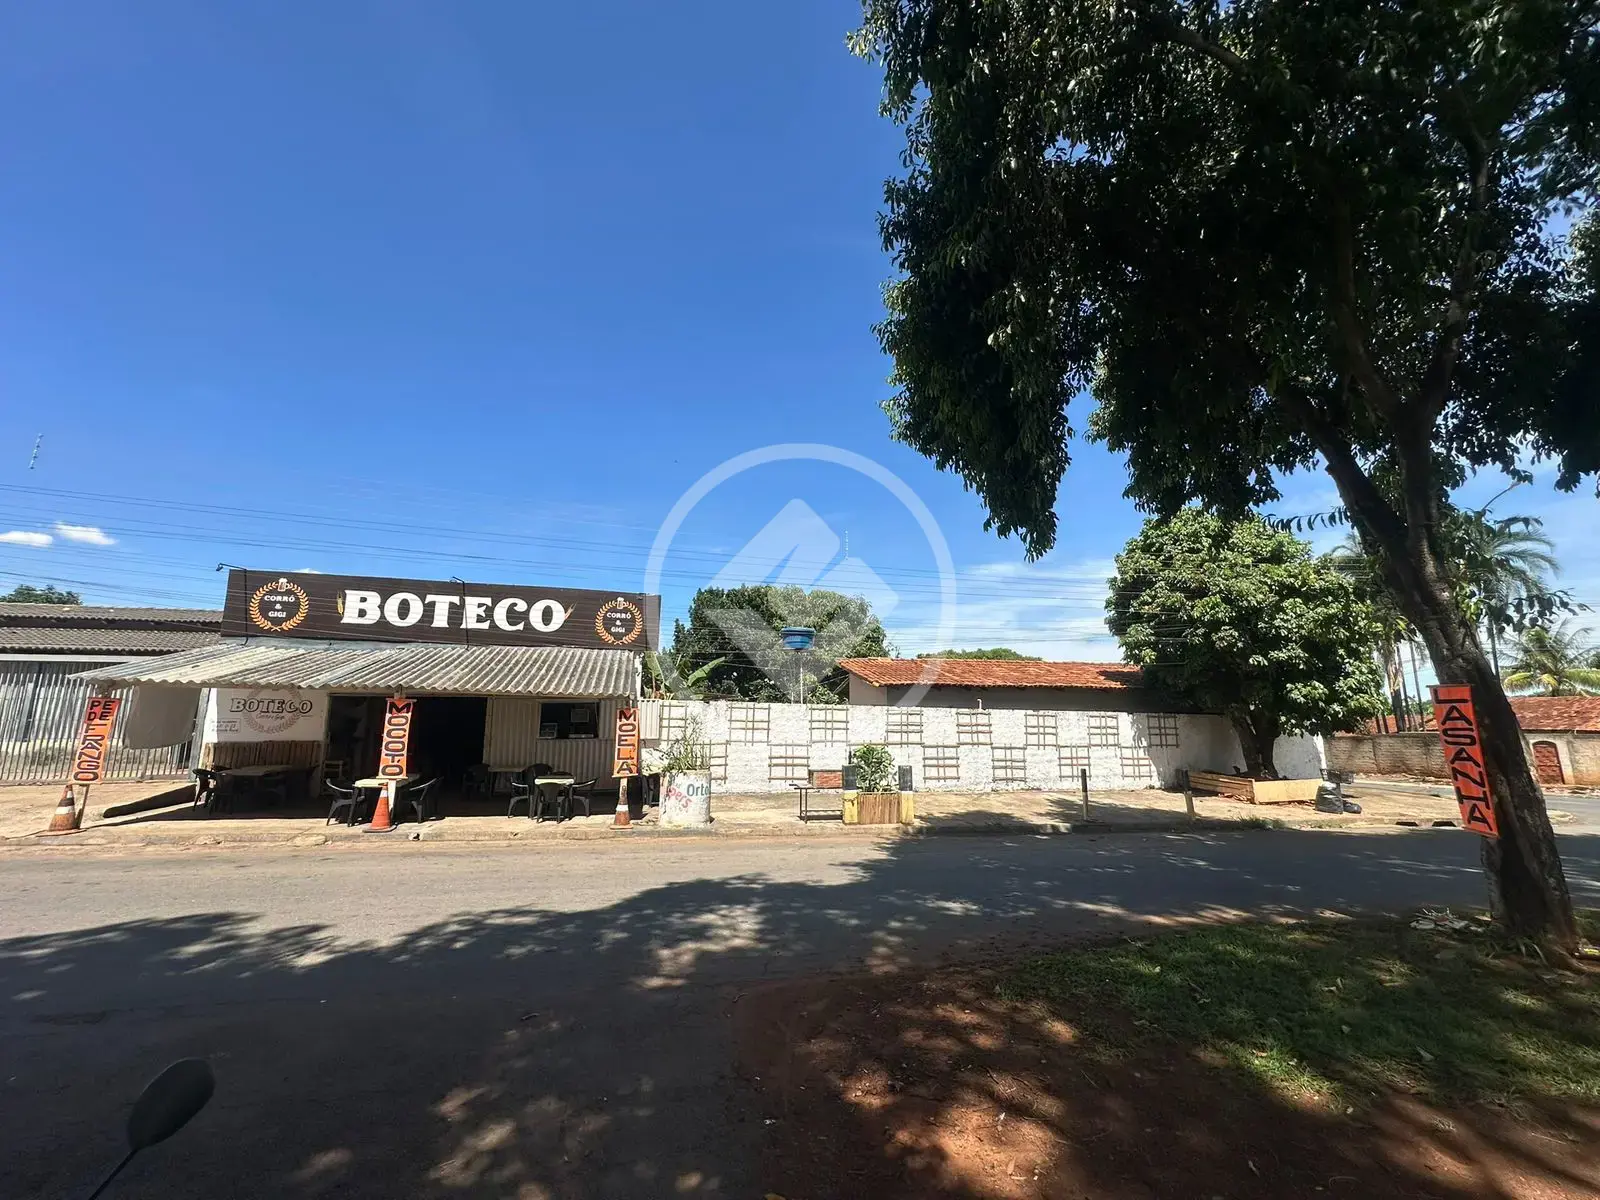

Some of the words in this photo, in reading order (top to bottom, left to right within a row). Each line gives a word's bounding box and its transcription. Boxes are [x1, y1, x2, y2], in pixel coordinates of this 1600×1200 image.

[268, 610, 287, 618] GIGI
[340, 589, 566, 633] BOTECO
[87, 711, 111, 721] DE
[90, 700, 115, 711] PE
[229, 698, 313, 714] BOTECO
[73, 723, 107, 782] FRANGO
[616, 709, 637, 774] MOELA
[1434, 688, 1493, 832] LASANHA
